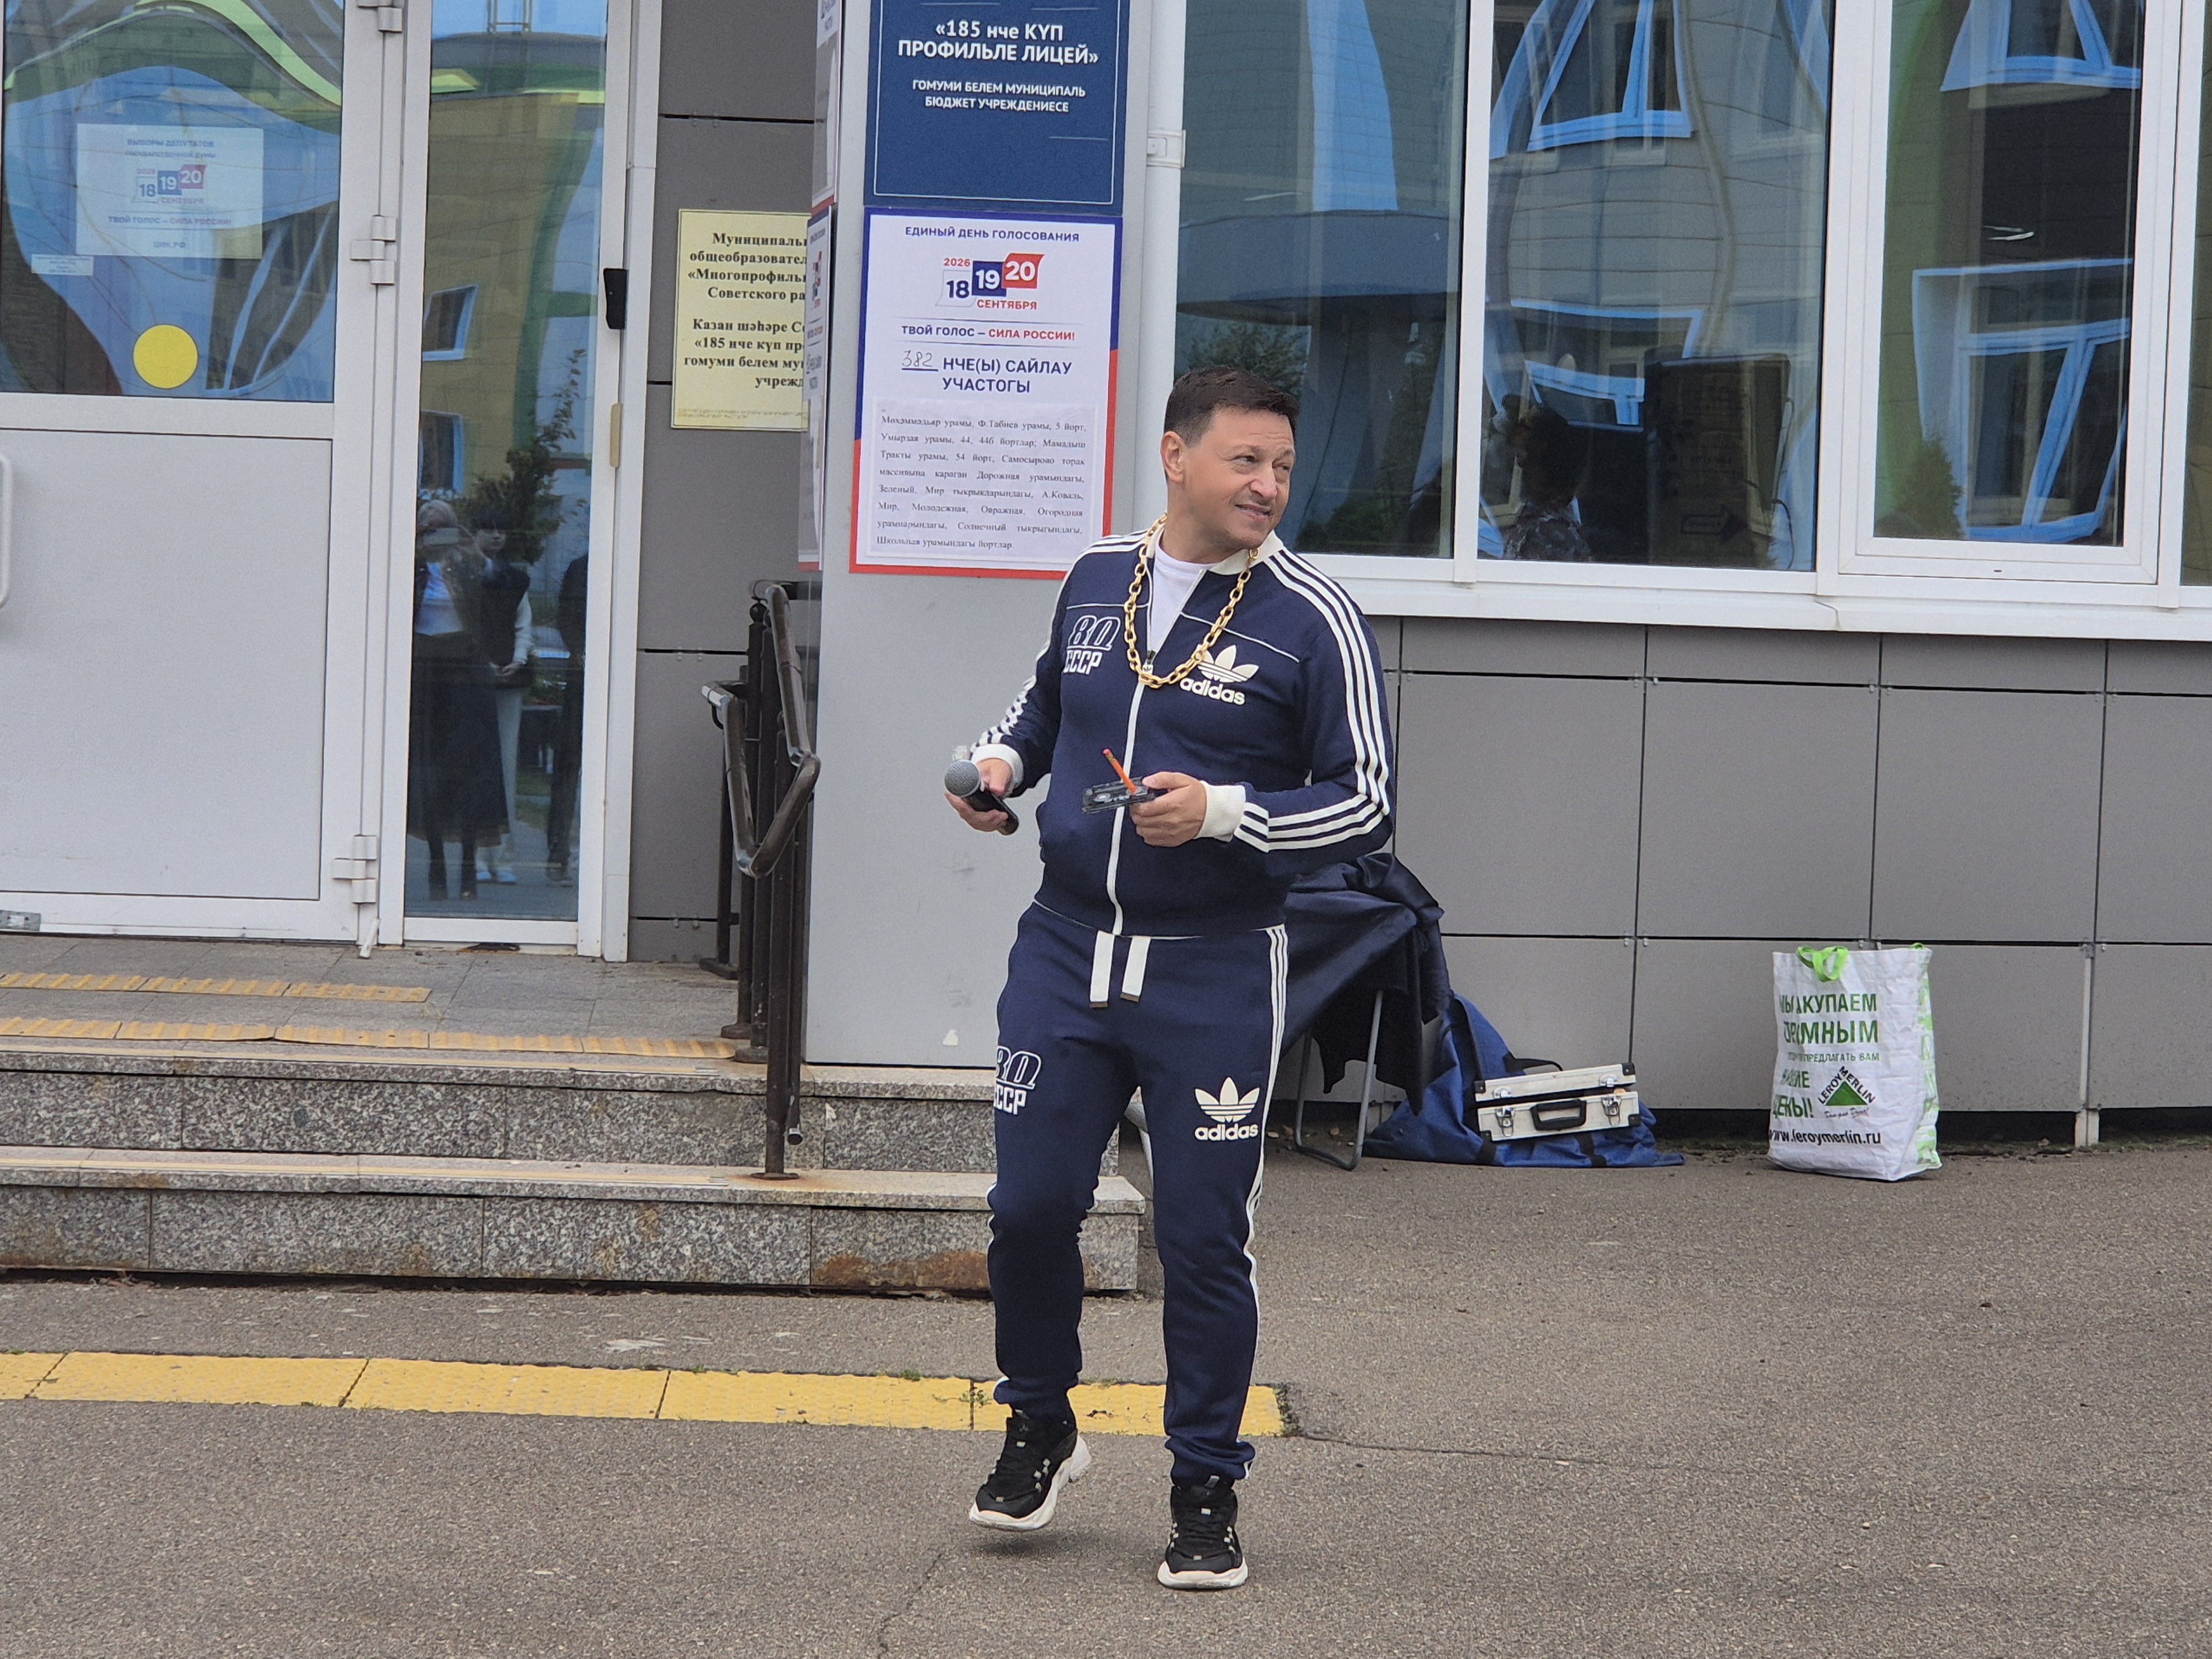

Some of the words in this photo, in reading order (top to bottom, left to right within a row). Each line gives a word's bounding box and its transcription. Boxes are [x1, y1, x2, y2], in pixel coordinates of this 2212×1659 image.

[936, 20, 980, 38] «185
[987, 25, 1019, 39] нче
[1025, 24, 1063, 41] КҮП
[898, 40, 1017, 61] ПРОФИЛЬЛЕ
[1021, 44, 1098, 65] ЛИЦЕЙ»
[912, 80, 962, 92] ГОМУМИ
[965, 82, 1003, 94] БЕЛЕМ
[1005, 83, 1086, 97] МУНИЦИПАЛЬ
[925, 96, 975, 109] БЮДЖЕТ
[978, 99, 1069, 112] УЧРЕЖДЕНИЕСЕ
[139, 184, 156, 197] 18
[160, 176, 177, 190] 19
[180, 170, 202, 183] 20
[905, 226, 955, 237] ЕДИНЫЙ
[958, 228, 989, 239] ДЕНЬ
[992, 230, 1079, 242] ГОЛОСОВАНИЯ
[943, 258, 971, 267] 2026
[946, 280, 969, 298] 18
[975, 270, 1000, 289] 19
[1005, 262, 1036, 281] 20
[708, 287, 786, 300] Советского
[977, 299, 1037, 310] СЕНТЯБРЯ
[693, 319, 733, 331] Казан
[791, 321, 805, 332] С
[901, 325, 932, 336] ТВОЙ
[936, 327, 974, 337] ГОЛОС
[988, 329, 1020, 339] СИЛА
[1024, 330, 1074, 341] РОССИИ!
[695, 337, 725, 348] «185
[729, 340, 753, 349] нче
[757, 341, 781, 353] күп
[785, 342, 804, 353] пр
[684, 357, 734, 369] гомуми
[739, 356, 778, 368] белем
[901, 350, 933, 368] 382
[943, 357, 1001, 375] НЧЕ(Ы)
[1005, 358, 1072, 374] САЙЛАУ
[942, 378, 1030, 393] УЧАСТОГЫ
[977, 471, 1019, 481] Дорожная
[925, 486, 945, 496] Мир
[1067, 615, 1120, 650] 80
[1063, 650, 1103, 675] СССР
[1180, 677, 1245, 705] adidas
[1860, 1053, 1880, 1061] ВАМ
[1818, 1072, 1842, 1104] LEROY
[1839, 1066, 1875, 1103] MERLIN
[1195, 1124, 1258, 1141] adidas
